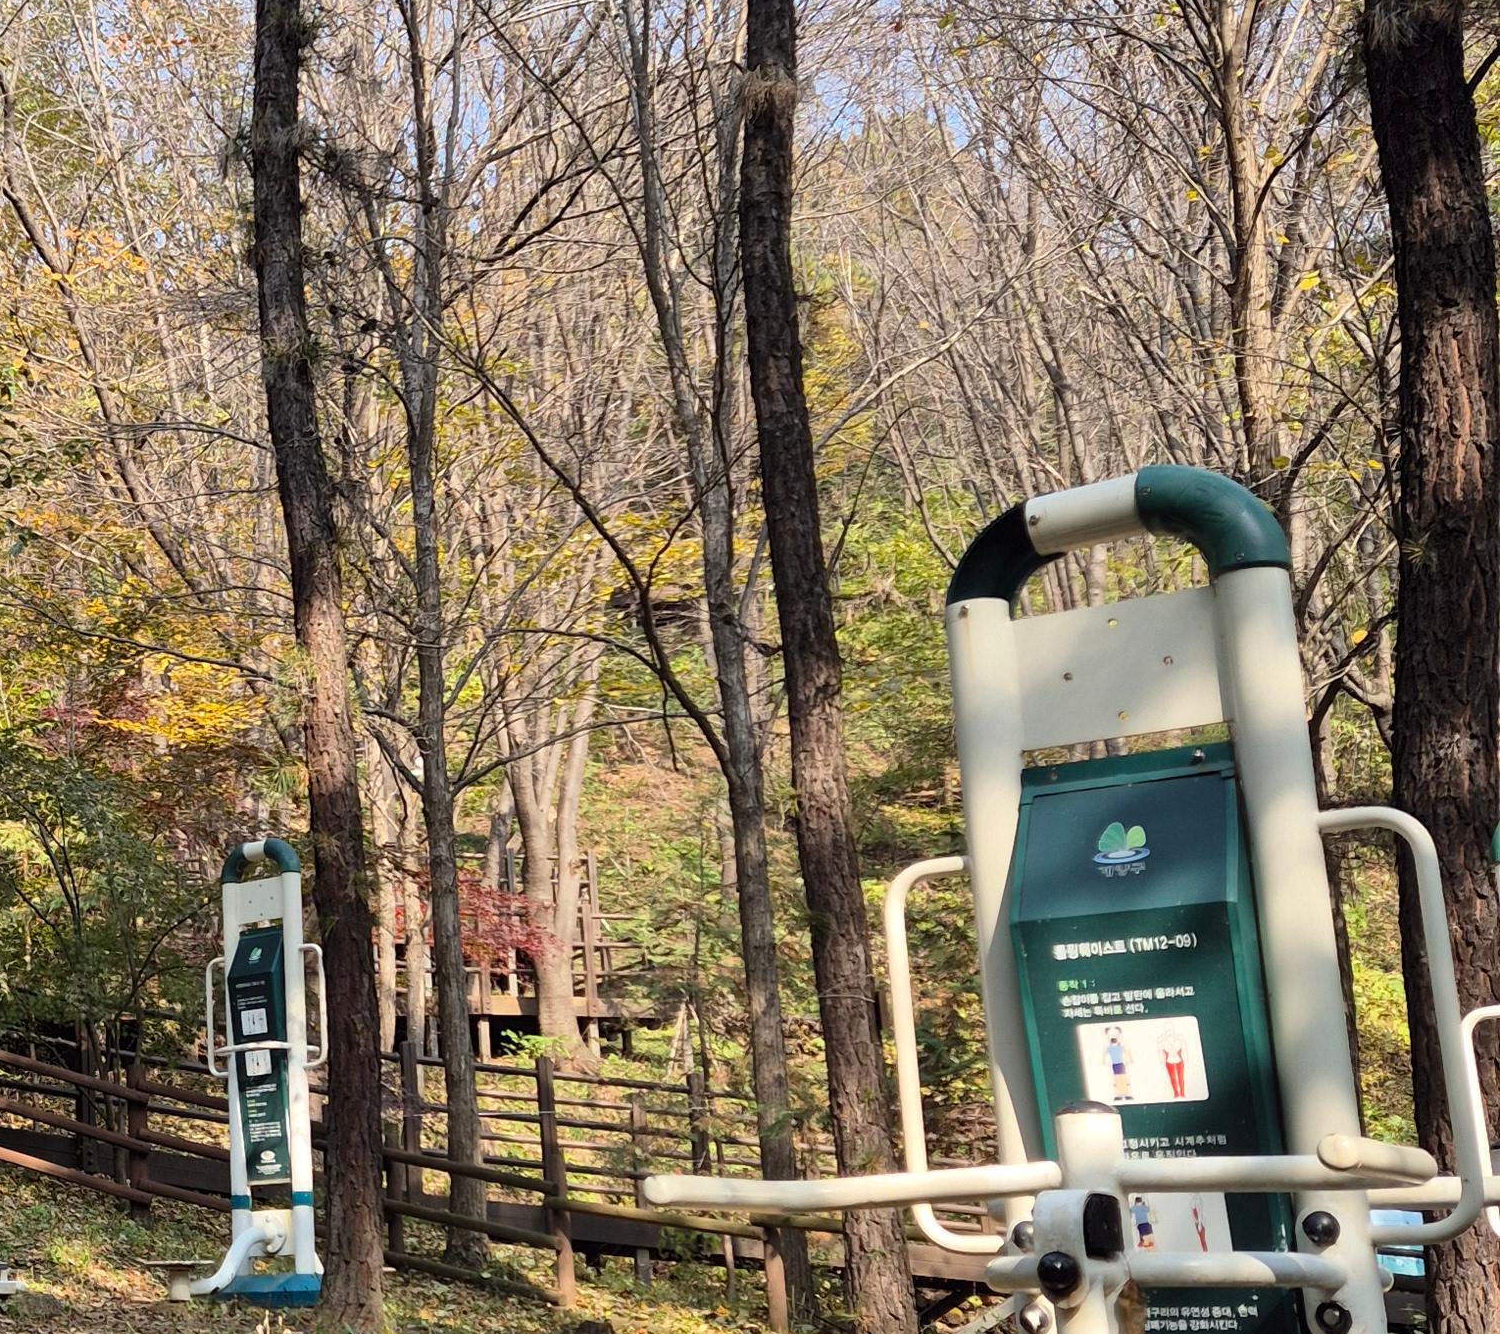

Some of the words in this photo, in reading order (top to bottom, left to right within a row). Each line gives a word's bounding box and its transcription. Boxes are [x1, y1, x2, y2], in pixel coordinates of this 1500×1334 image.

[1129, 932, 1197, 954] (TM12-09)
[1154, 986, 1195, 999] 올라서고
[1181, 1306, 1210, 1318] 유연성
